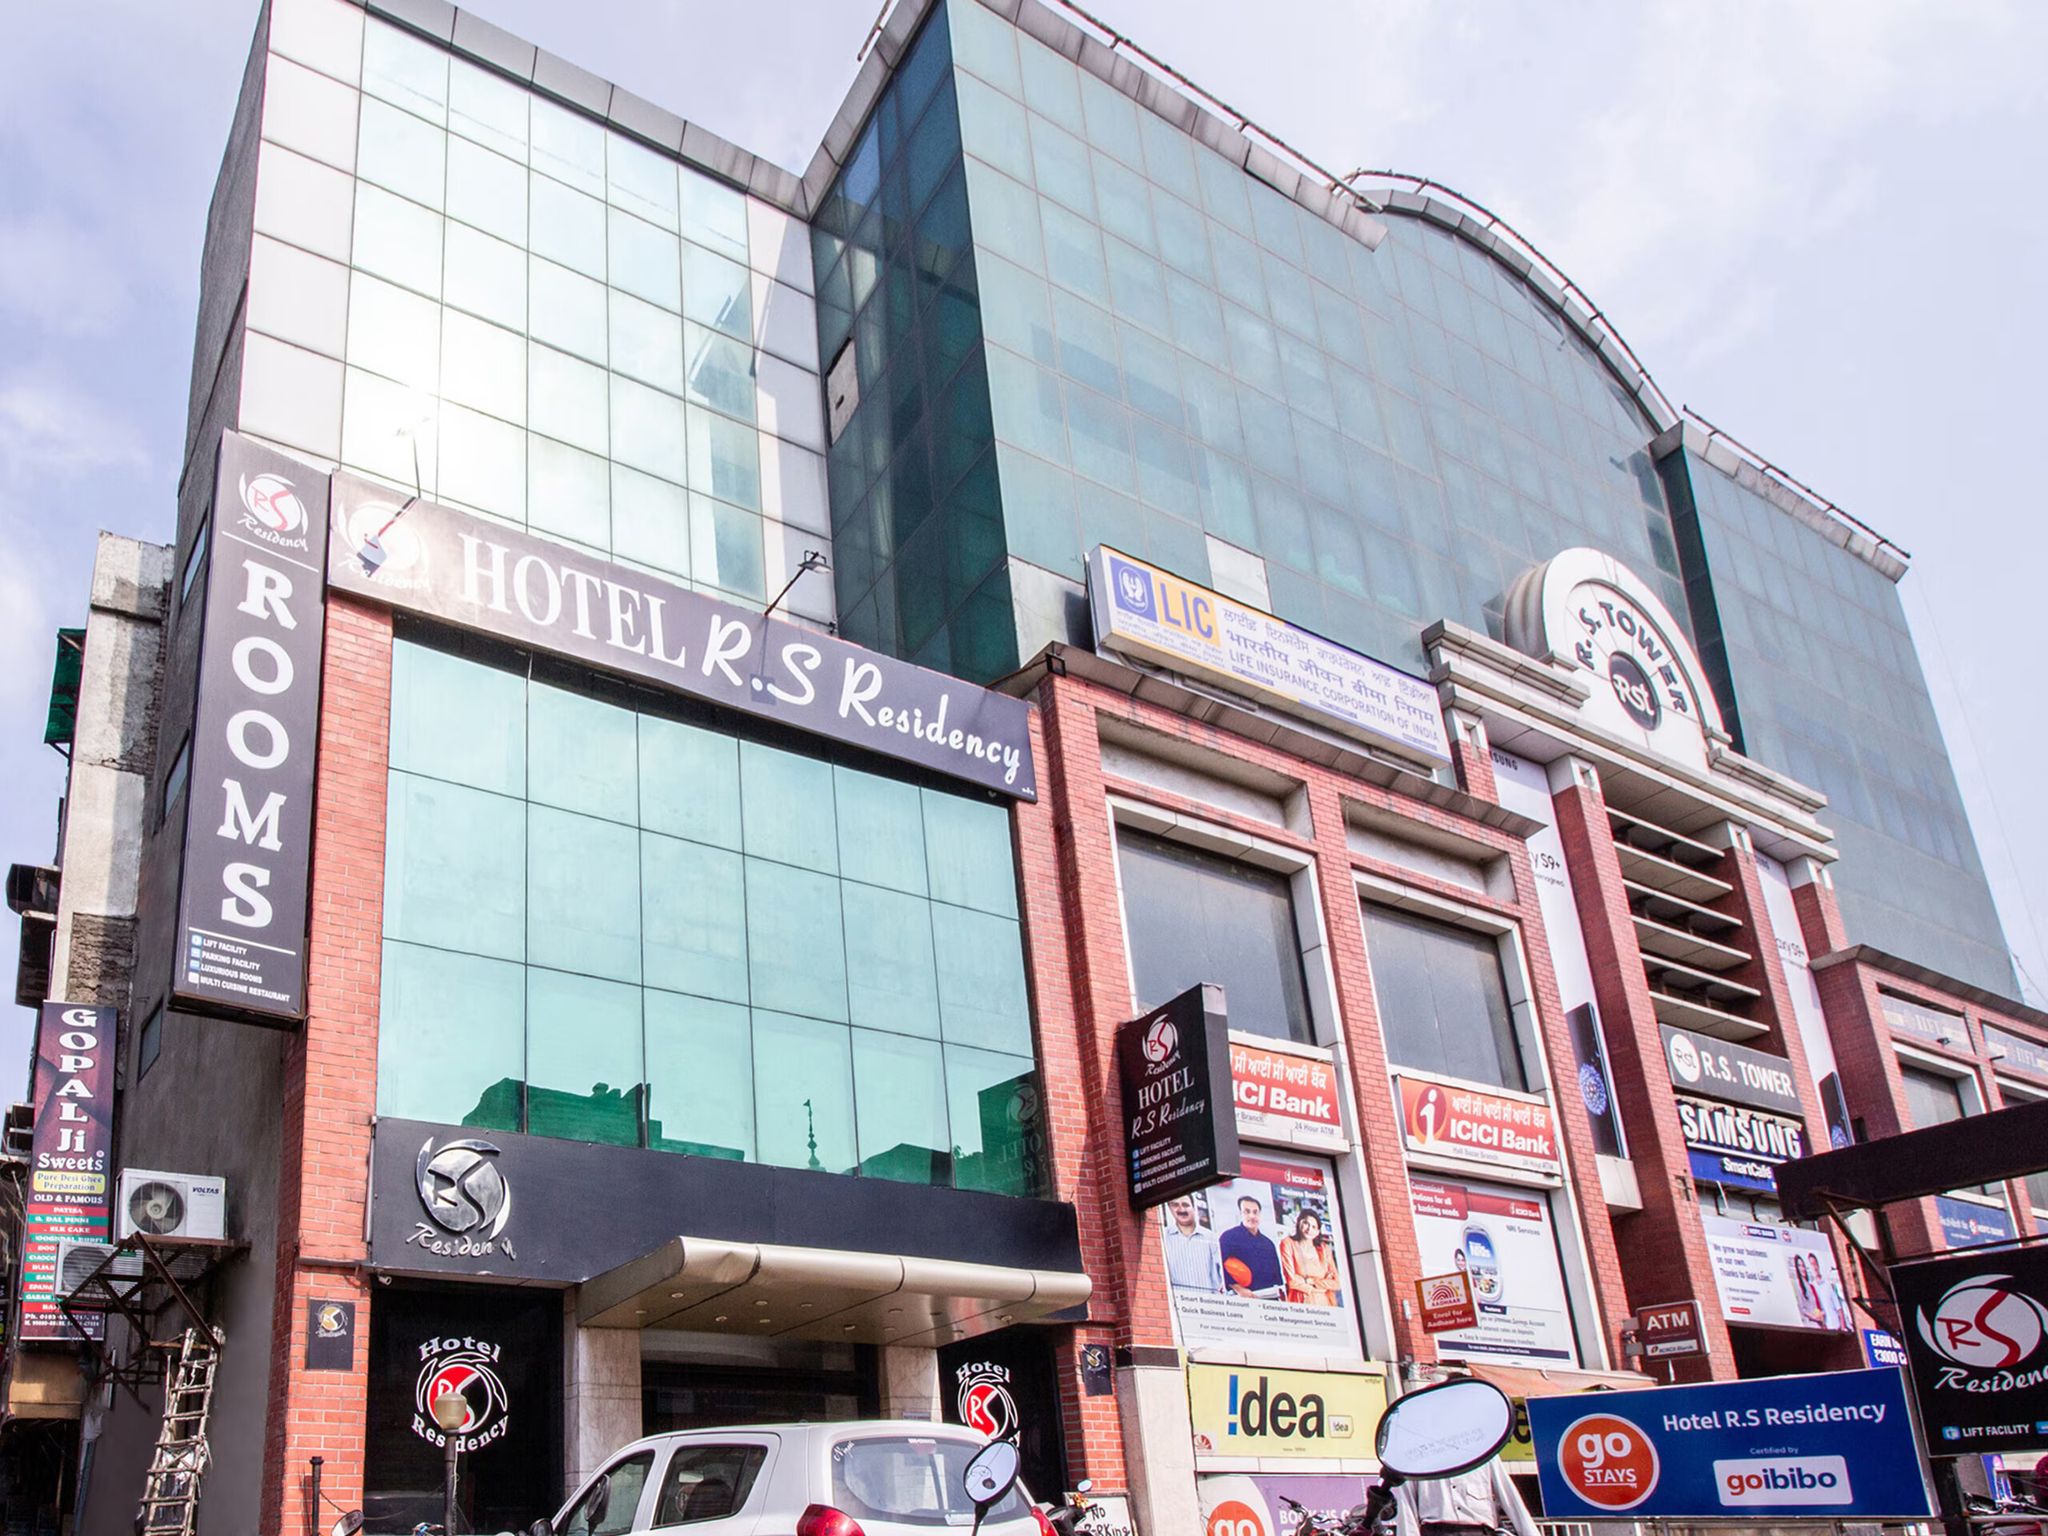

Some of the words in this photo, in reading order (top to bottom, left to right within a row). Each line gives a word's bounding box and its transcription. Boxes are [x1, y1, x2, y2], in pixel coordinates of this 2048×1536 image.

[237, 512, 308, 552] Residency
[1160, 583, 1213, 639] LIC
[457, 533, 686, 669] HOTEL
[838, 657, 1020, 785] Residency
[1598, 601, 1688, 713] TOWER
[1226, 628, 1289, 666] भारतीय
[1297, 658, 1344, 688] जीवन
[1351, 678, 1387, 706] बीमा
[1394, 694, 1435, 726] निगम
[1229, 648, 1255, 669] LIFE
[1256, 659, 1321, 696] INSURANCE
[1322, 686, 1395, 724] CORPORATION
[1397, 716, 1409, 730] OF
[1412, 723, 1439, 742] INDIA
[217, 559, 297, 928] ROOMS
[1491, 752, 1519, 771] SUNG
[203, 938, 217, 948] LIFT
[218, 942, 247, 955] FACILITY
[201, 951, 231, 964] PARKING
[232, 959, 260, 971] FACILITY
[200, 976, 221, 988] MULTI
[221, 980, 248, 994] CUISINE
[249, 986, 290, 1002] RESTAURANT
[239, 971, 262, 984] ROOMS
[56, 1008, 98, 1123] GOPAL
[1700, 1050, 1738, 1083] R.S.
[1737, 1060, 1795, 1098] TOWER
[1138, 1066, 1195, 1110] HOTEL
[1270, 1086, 1331, 1120] Bank
[1132, 1110, 1156, 1139] R.S
[1159, 1097, 1205, 1127] Residency
[57, 1128, 86, 1152] Ji
[1150, 1137, 1171, 1150] FACILITY
[1450, 1119, 1499, 1147] ICICI
[1502, 1128, 1550, 1155] Bank
[1680, 1104, 1801, 1159] SAMSUNG
[37, 1153, 104, 1171] Sweets
[1161, 1144, 1183, 1158] FACILITY
[38, 1173, 57, 1181] Pure
[81, 1175, 103, 1184] Ghee
[1176, 1158, 1210, 1176] RESTAURANT
[34, 1194, 53, 1202] OLD
[64, 1195, 103, 1205] FAMOUS
[44, 1181, 96, 1192] Preparation
[1647, 1311, 1689, 1331] ATM
[419, 1336, 501, 1363] Hotel
[956, 1361, 1010, 1383] Hotel
[1663, 1412, 1721, 1432] Hotel
[1725, 1409, 1760, 1429] R.S
[1768, 1399, 1887, 1428] Residency
[411, 1413, 509, 1453] Resdency
[1962, 1427, 1983, 1438] LIFT
[1986, 1424, 2030, 1436] FACILITY
[1577, 1431, 1632, 1469] go
[1749, 1446, 1786, 1455] Certified
[1787, 1446, 1799, 1455] by
[1584, 1467, 1637, 1484] STAYS
[1726, 1466, 1837, 1496] goibibo
[1091, 1504, 1106, 1520] NO
